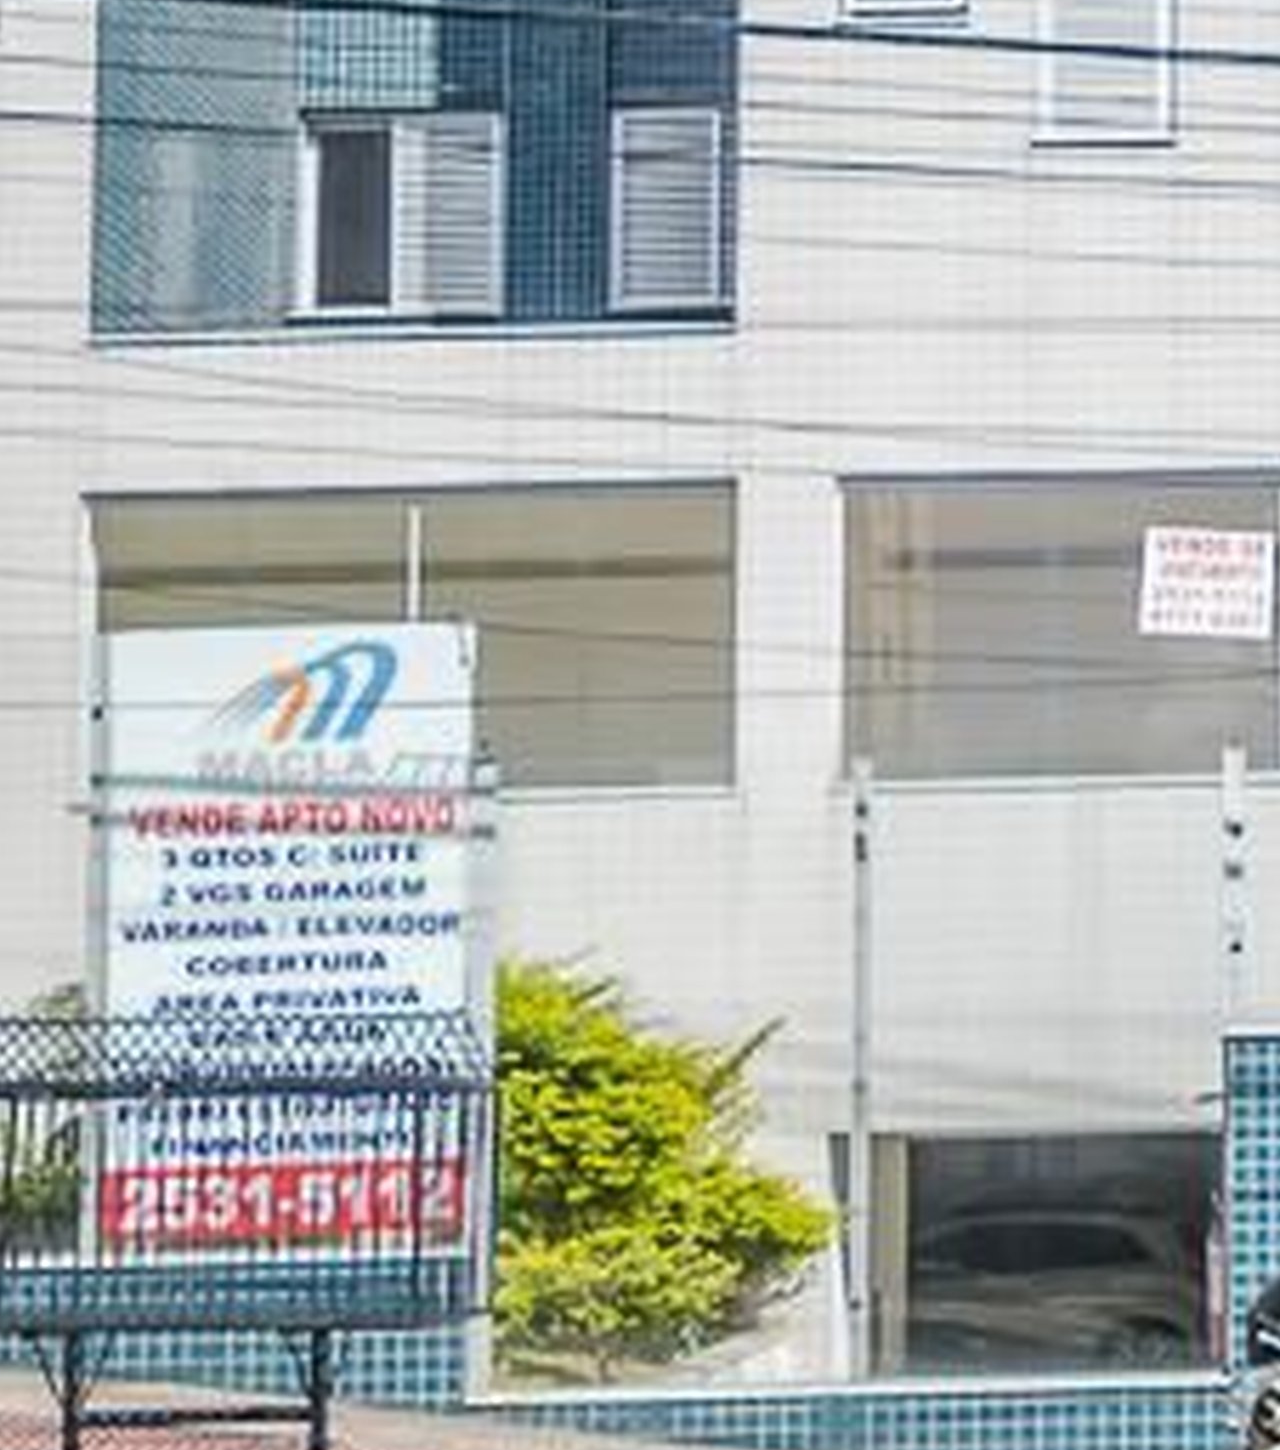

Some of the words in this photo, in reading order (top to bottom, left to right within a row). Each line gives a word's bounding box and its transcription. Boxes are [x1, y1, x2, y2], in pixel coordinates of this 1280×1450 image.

[129, 802, 247, 838] VENDE
[257, 800, 348, 835] APTO
[360, 797, 456, 835] NOVO
[160, 884, 176, 907] 2
[186, 882, 252, 903] VGS
[264, 875, 427, 901] GARAGEM
[122, 918, 269, 943] VARANDA
[296, 911, 460, 937] ELEVADOR
[184, 950, 389, 976] COBERTURA
